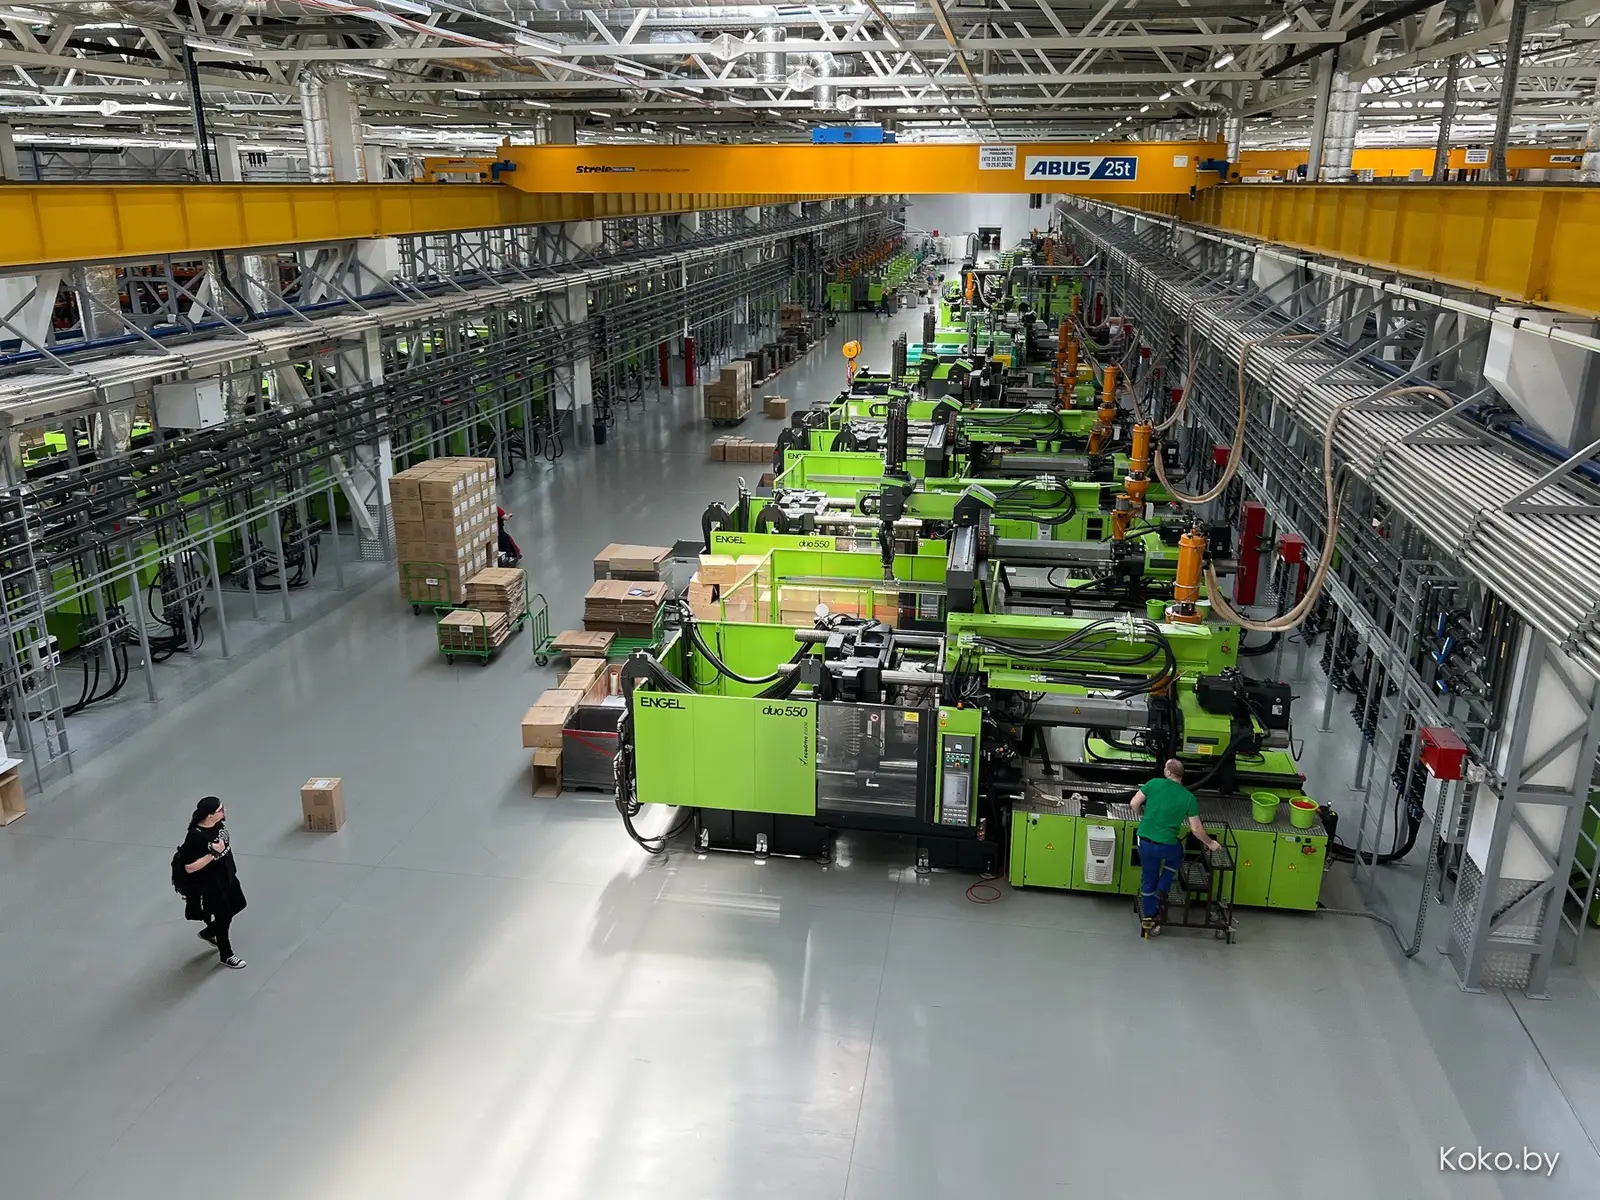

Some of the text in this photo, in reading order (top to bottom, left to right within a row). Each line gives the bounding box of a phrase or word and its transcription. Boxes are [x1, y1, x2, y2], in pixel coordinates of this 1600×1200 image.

[576, 165, 612, 174] Strele
[1030, 161, 1131, 176] ABUS 25t
[715, 536, 746, 545] ENGEL
[798, 540, 830, 549] duo 550
[640, 697, 686, 710] ENGEL
[762, 705, 808, 718] duo 550
